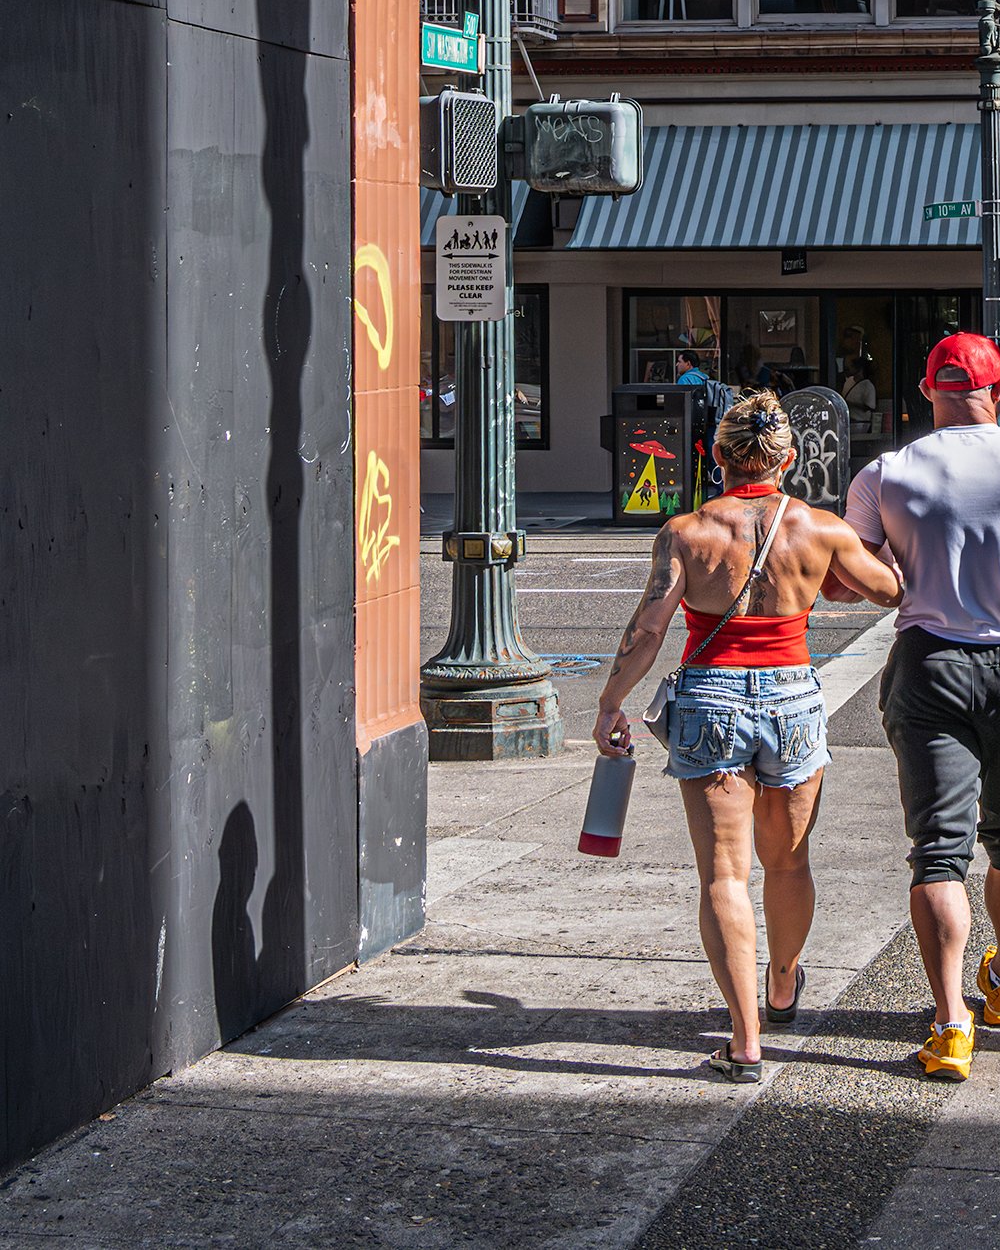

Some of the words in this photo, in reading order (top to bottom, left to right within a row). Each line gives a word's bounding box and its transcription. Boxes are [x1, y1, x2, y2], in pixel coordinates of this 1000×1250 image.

[925, 208, 933, 219] SW
[938, 204, 956, 217] 10TH
[960, 203, 972, 216] AV
